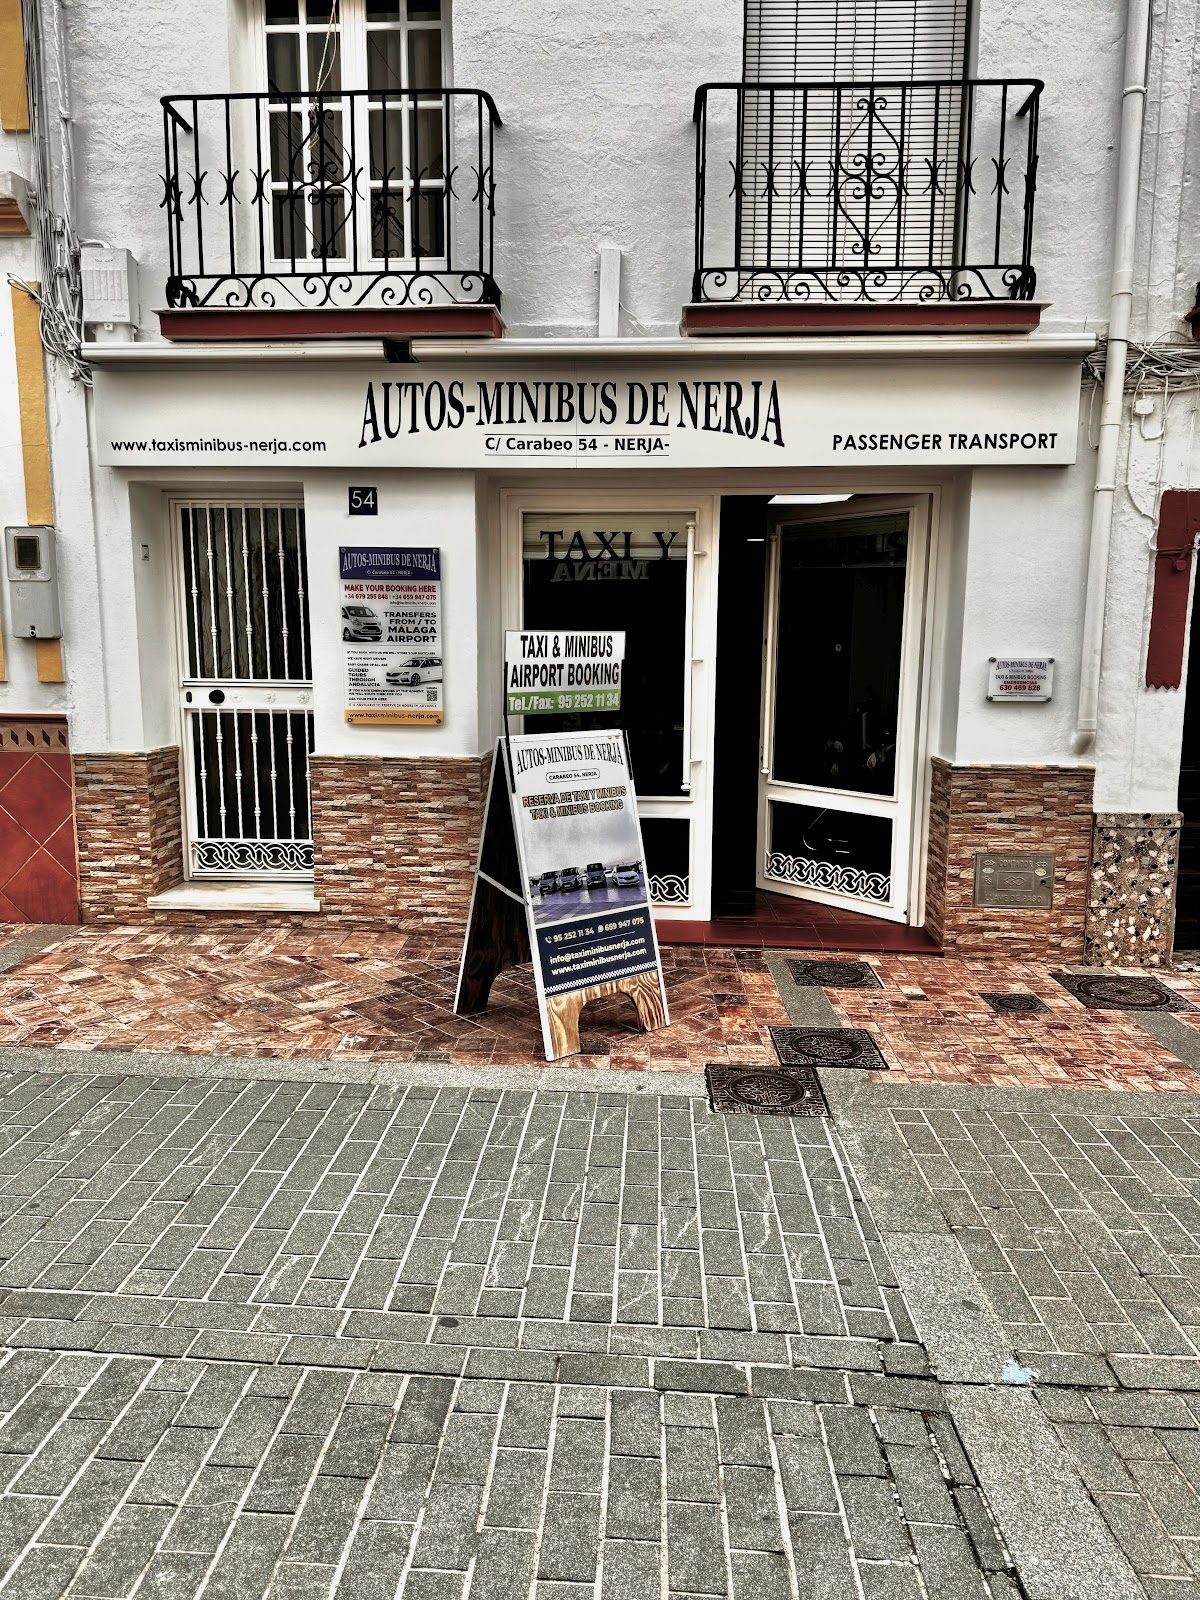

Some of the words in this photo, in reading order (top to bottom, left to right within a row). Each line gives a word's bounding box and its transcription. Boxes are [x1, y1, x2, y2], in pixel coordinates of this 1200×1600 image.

[358, 380, 617, 448] AUTOS-MINIBUS
[626, 381, 670, 427] DE
[677, 380, 786, 448] NERJA
[110, 437, 327, 455] www.taxisminibus-nerja.com
[485, 437, 502, 452] C/
[505, 437, 573, 451] Carabeo
[578, 437, 598, 451] 54
[832, 433, 943, 451] PASSENGER
[948, 433, 1058, 450] TRANSPORT
[351, 490, 375, 508] 54
[540, 530, 634, 561] TAXI
[652, 531, 680, 561] Y
[342, 553, 400, 572] AUTOS-MINIBUS
[401, 553, 412, 567] DE
[412, 554, 437, 573] NERJA
[385, 585, 417, 593] BOOKING
[418, 585, 437, 593] HERE
[387, 635, 437, 643] AIRPORT
[520, 635, 548, 659] TAXI
[552, 635, 561, 658] &
[564, 635, 613, 658] MINIBUS
[510, 664, 564, 688] AIRPORT
[567, 663, 620, 686] BOOKING
[509, 695, 554, 711] Tel./Fax:
[558, 695, 573, 709] 95
[574, 694, 593, 708] 252
[595, 693, 605, 707] 11
[606, 692, 620, 706] 34
[517, 744, 583, 775] AUTOS-MINIBUS
[584, 743, 596, 760] DE
[595, 742, 624, 765] NERJA
[522, 793, 561, 808] RESERVA
[560, 791, 572, 803] DE
[572, 790, 589, 802] TAXI
[589, 789, 597, 800] Y
[597, 786, 627, 799] MINIBUS
[530, 807, 549, 820] TAXI
[550, 806, 557, 818] &
[557, 802, 589, 817] MINIBUS
[589, 799, 624, 813] BOOKING
[552, 933, 562, 943] 95
[564, 931, 577, 940] 252
[584, 927, 594, 936] 34
[604, 922, 618, 931] 659
[618, 919, 631, 928] 947
[631, 917, 645, 925] 075
[549, 937, 645, 965] info@taximinibusnerja.com
[551, 947, 647, 976] www.taximinibusnerja.com
